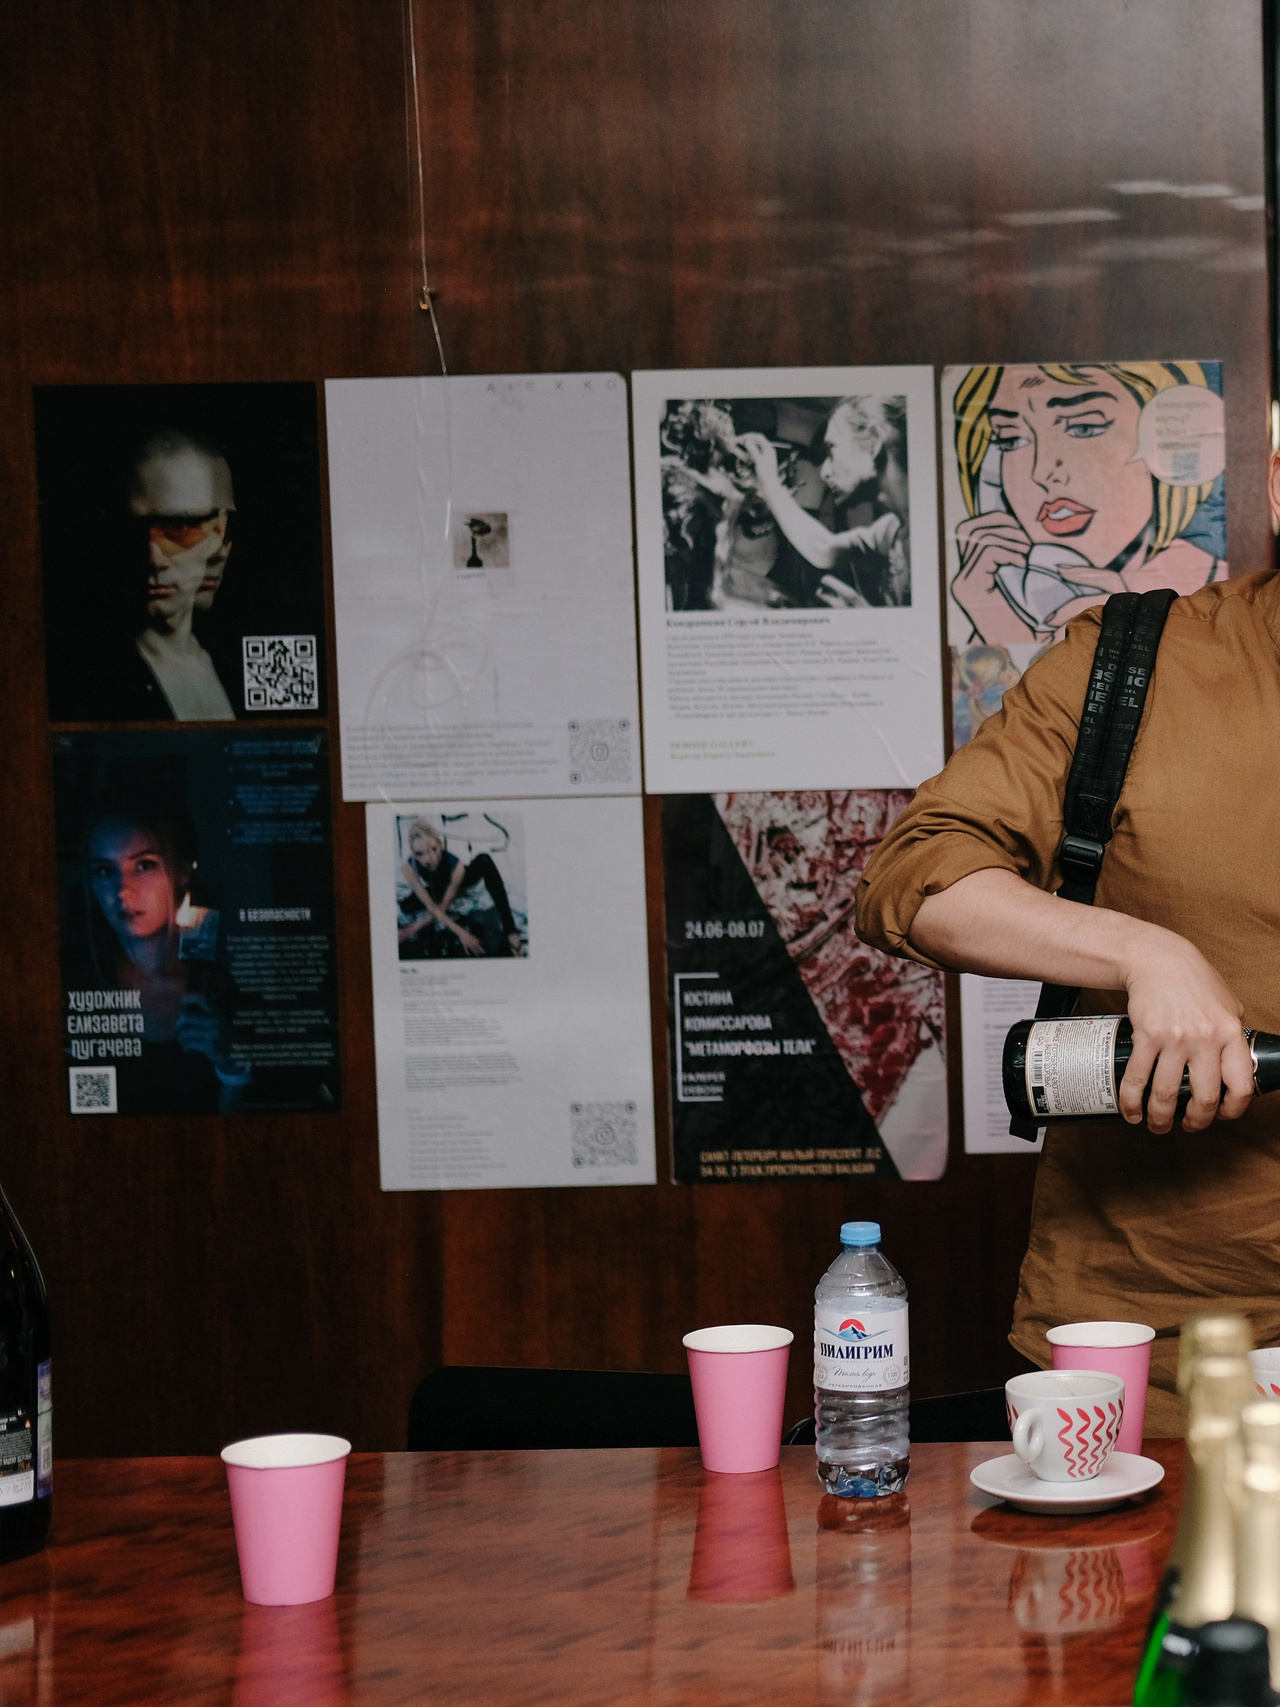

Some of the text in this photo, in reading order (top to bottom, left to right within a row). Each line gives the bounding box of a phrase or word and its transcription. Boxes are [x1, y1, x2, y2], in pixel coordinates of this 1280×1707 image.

[685, 921, 764, 939] 24.06-08.07
[684, 1015, 773, 1032] КОМИССАРОВА
[820, 1342, 893, 1359] ПИЛИГРИМ
